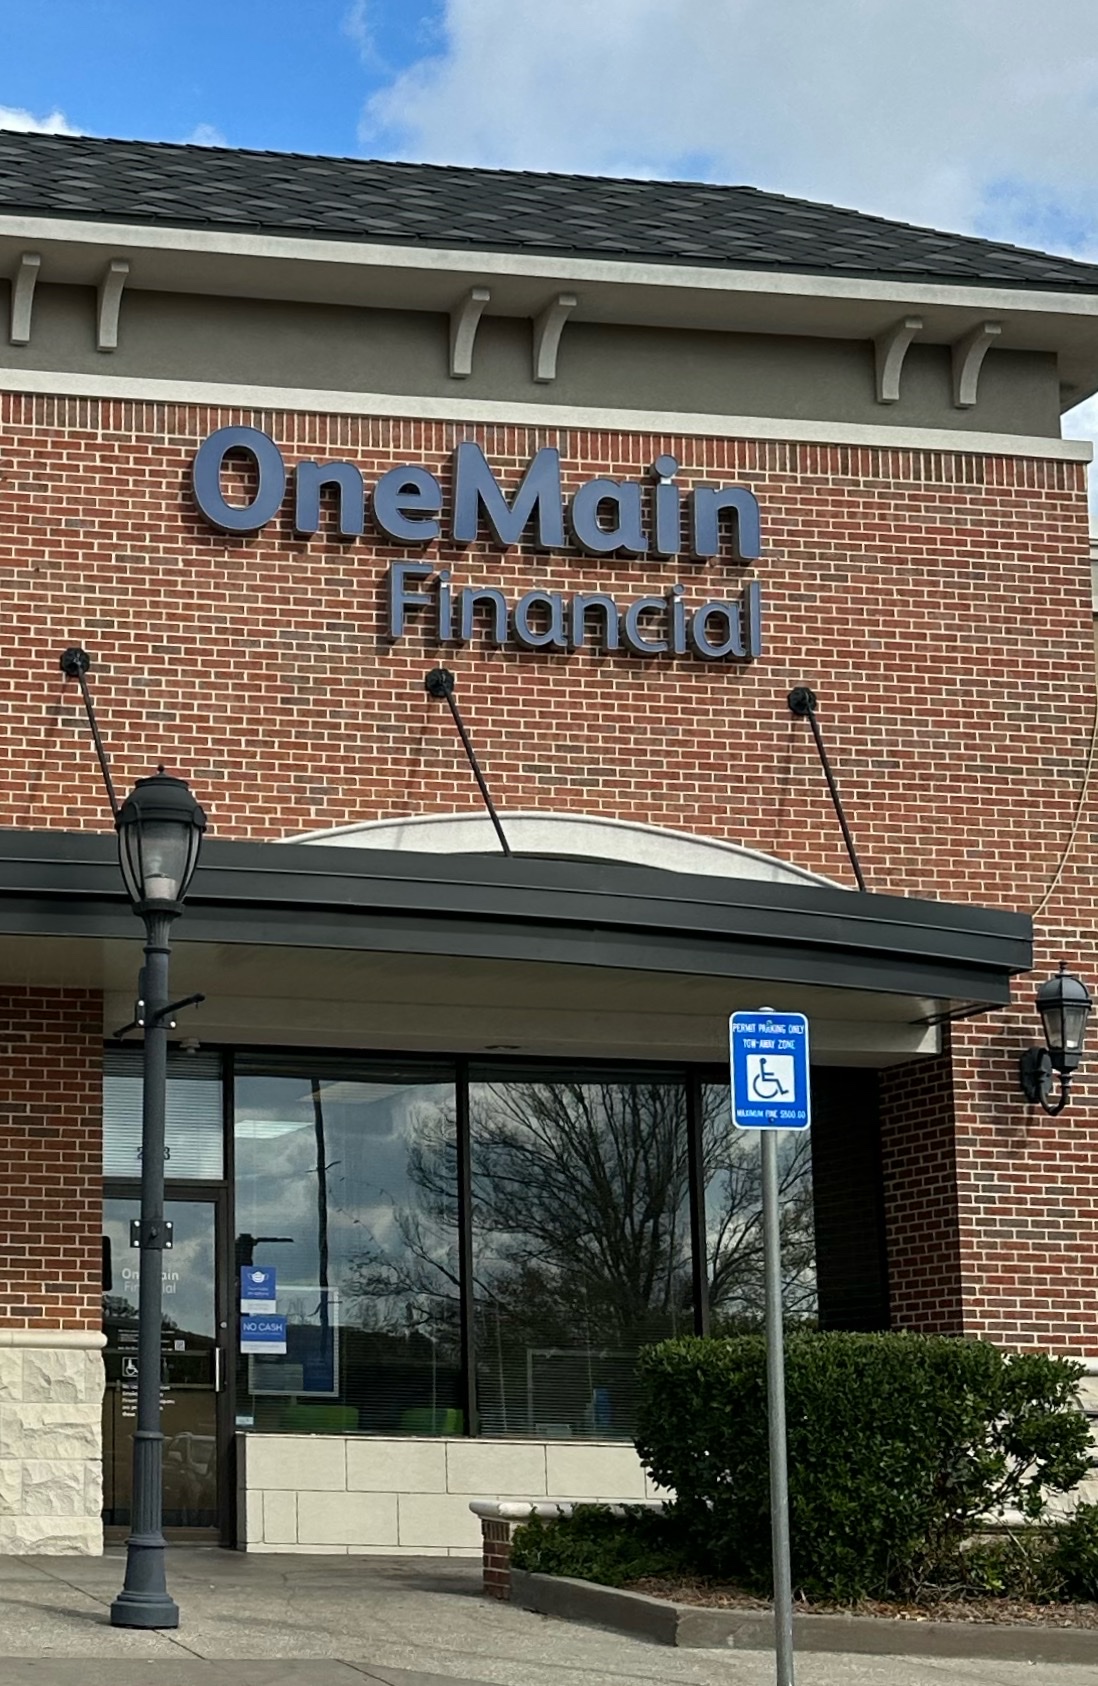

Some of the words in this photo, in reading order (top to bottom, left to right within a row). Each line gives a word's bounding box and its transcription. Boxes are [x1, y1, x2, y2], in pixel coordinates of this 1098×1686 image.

[192, 425, 762, 561] OneMain
[388, 561, 762, 660] Financial
[732, 1023, 756, 1033] PERMIT
[758, 1024, 787, 1034] PARKING
[788, 1024, 805, 1034] ONLY
[743, 1039, 775, 1049] TOW-AWAY
[777, 1039, 796, 1050] ZONE
[736, 1109, 764, 1117] MAXIMUM
[765, 1109, 778, 1118] FINE
[121, 1268, 179, 1281] Onain
[243, 1322, 257, 1332] NO
[258, 1322, 283, 1332] CASH
